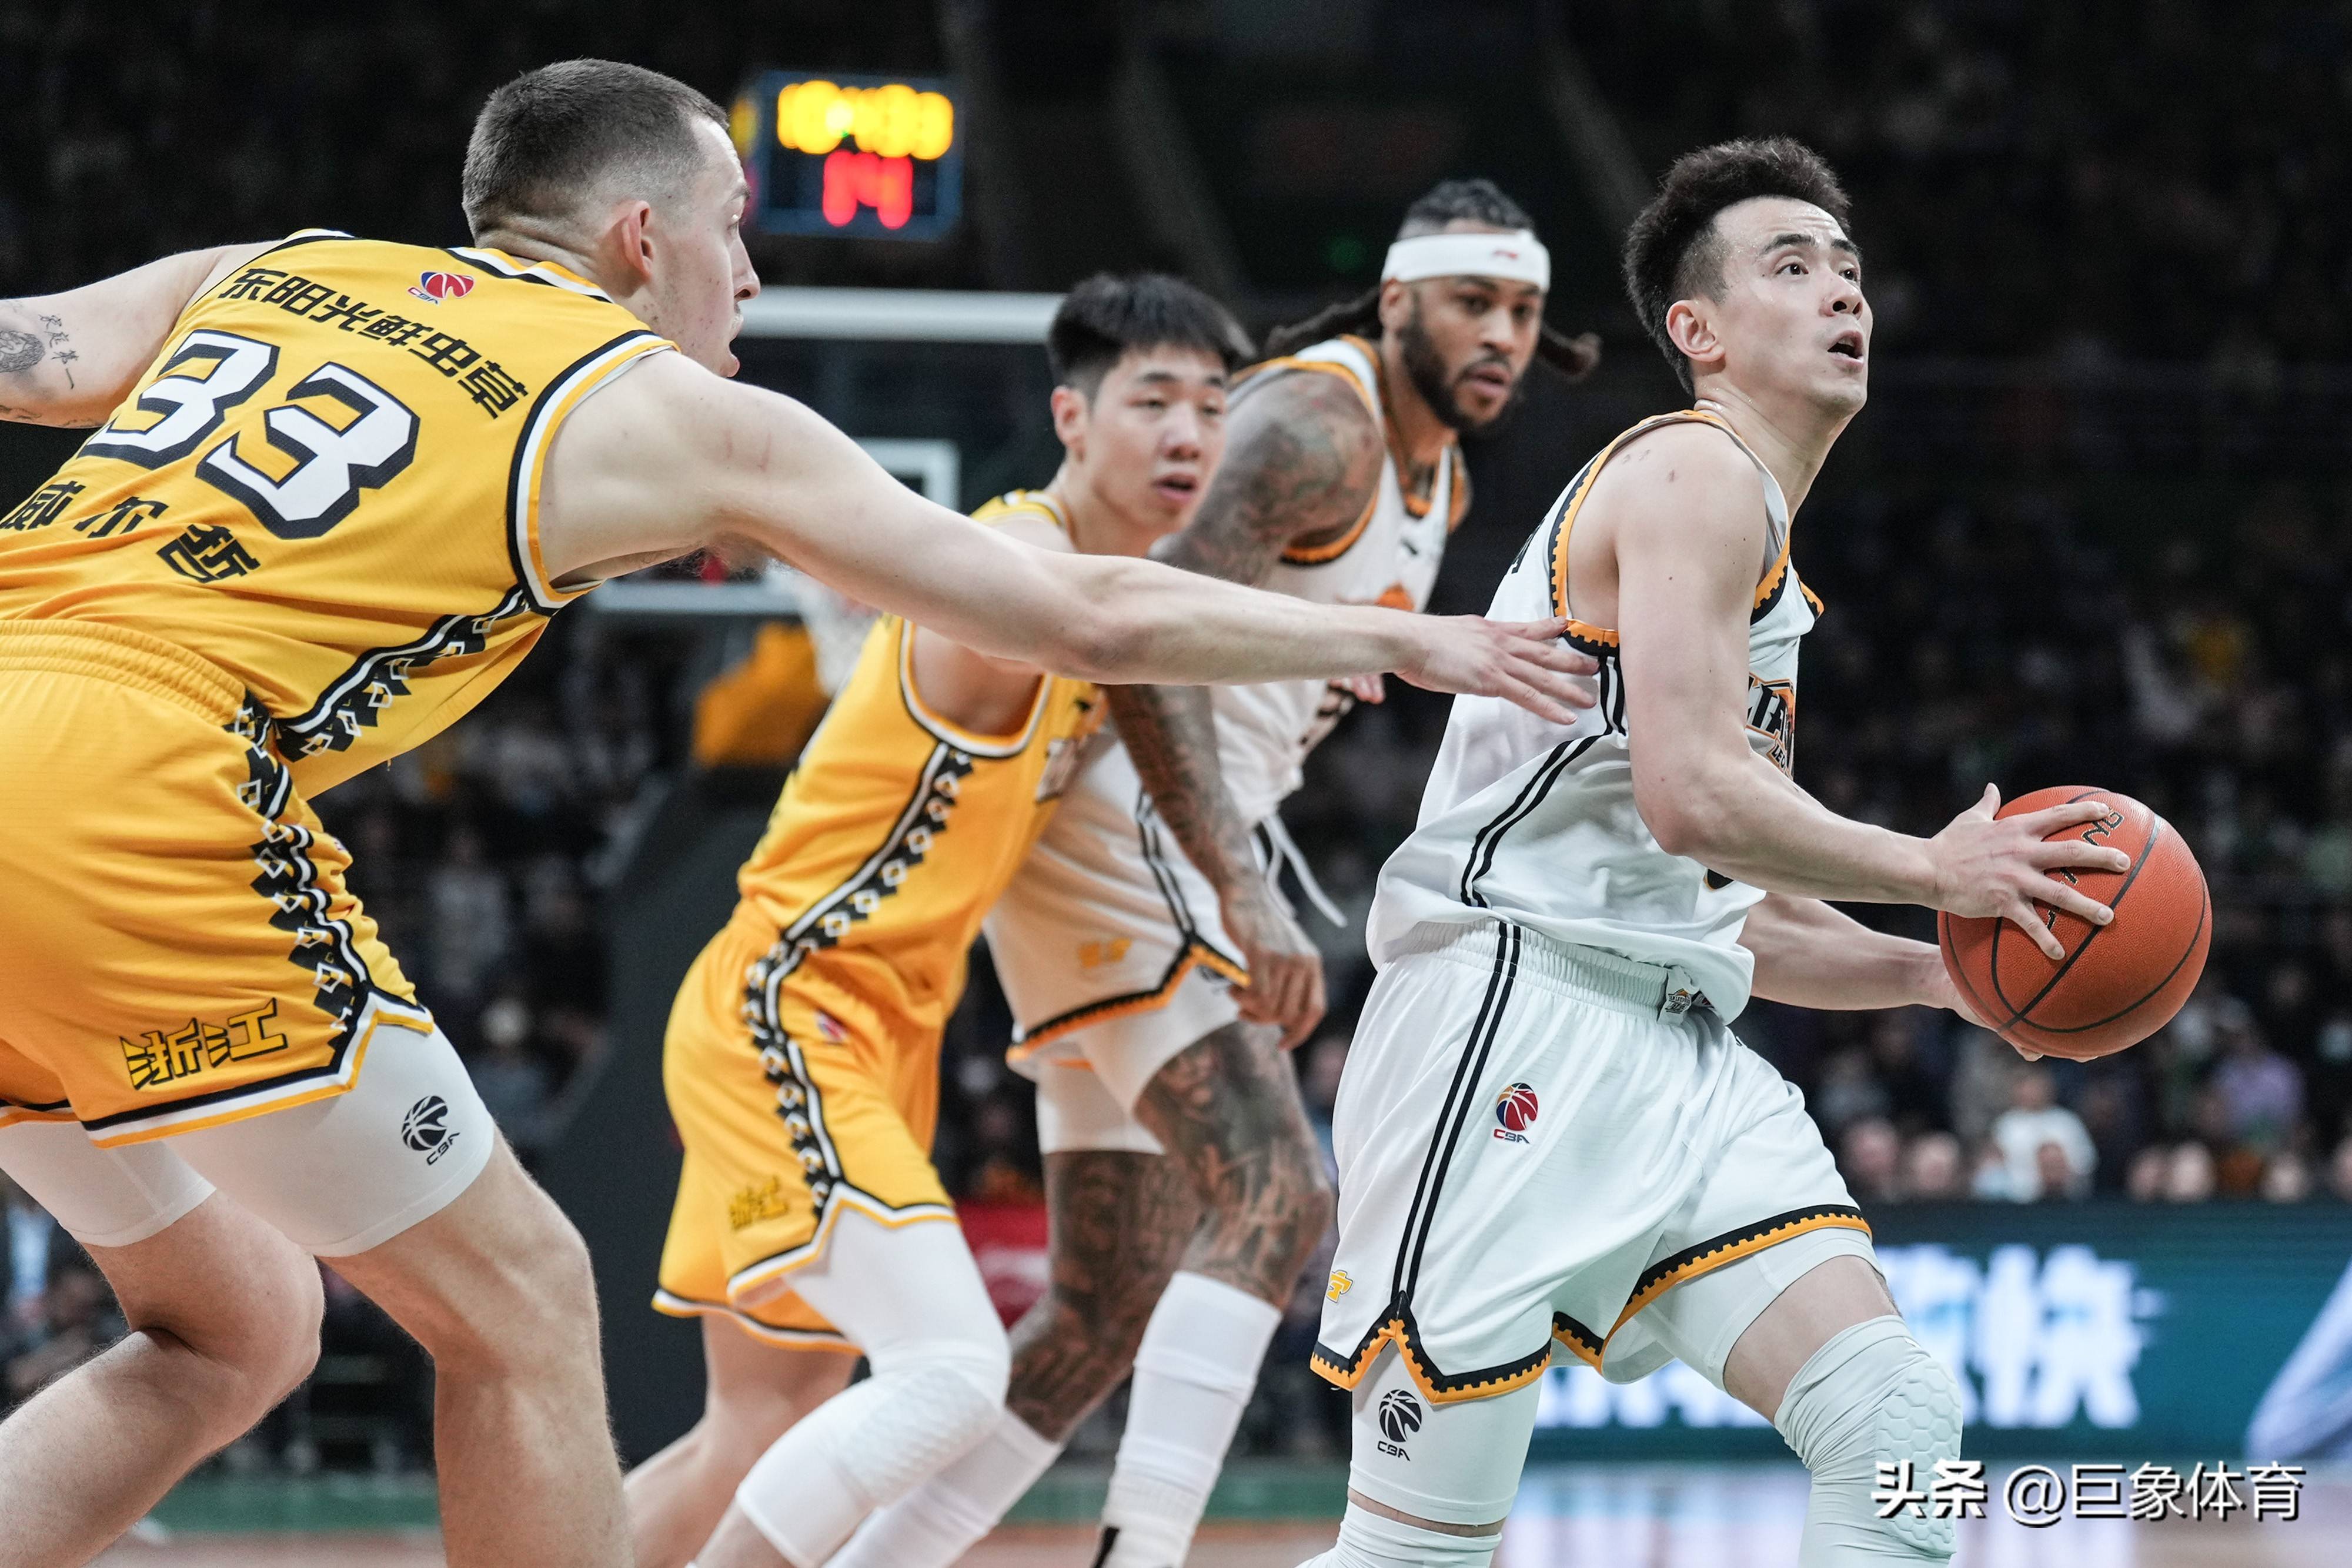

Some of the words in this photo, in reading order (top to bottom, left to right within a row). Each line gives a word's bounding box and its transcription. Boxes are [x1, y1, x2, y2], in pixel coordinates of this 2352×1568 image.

[407, 286, 439, 305] CBA
[218, 268, 529, 420] 东阳光鲜虫草
[76, 329, 420, 540] 33
[119, 997, 289, 1091] 浙江
[426, 1132, 460, 1166] CBA
[1494, 1128, 1531, 1145] CBA
[1378, 1440, 1411, 1462] CBA
